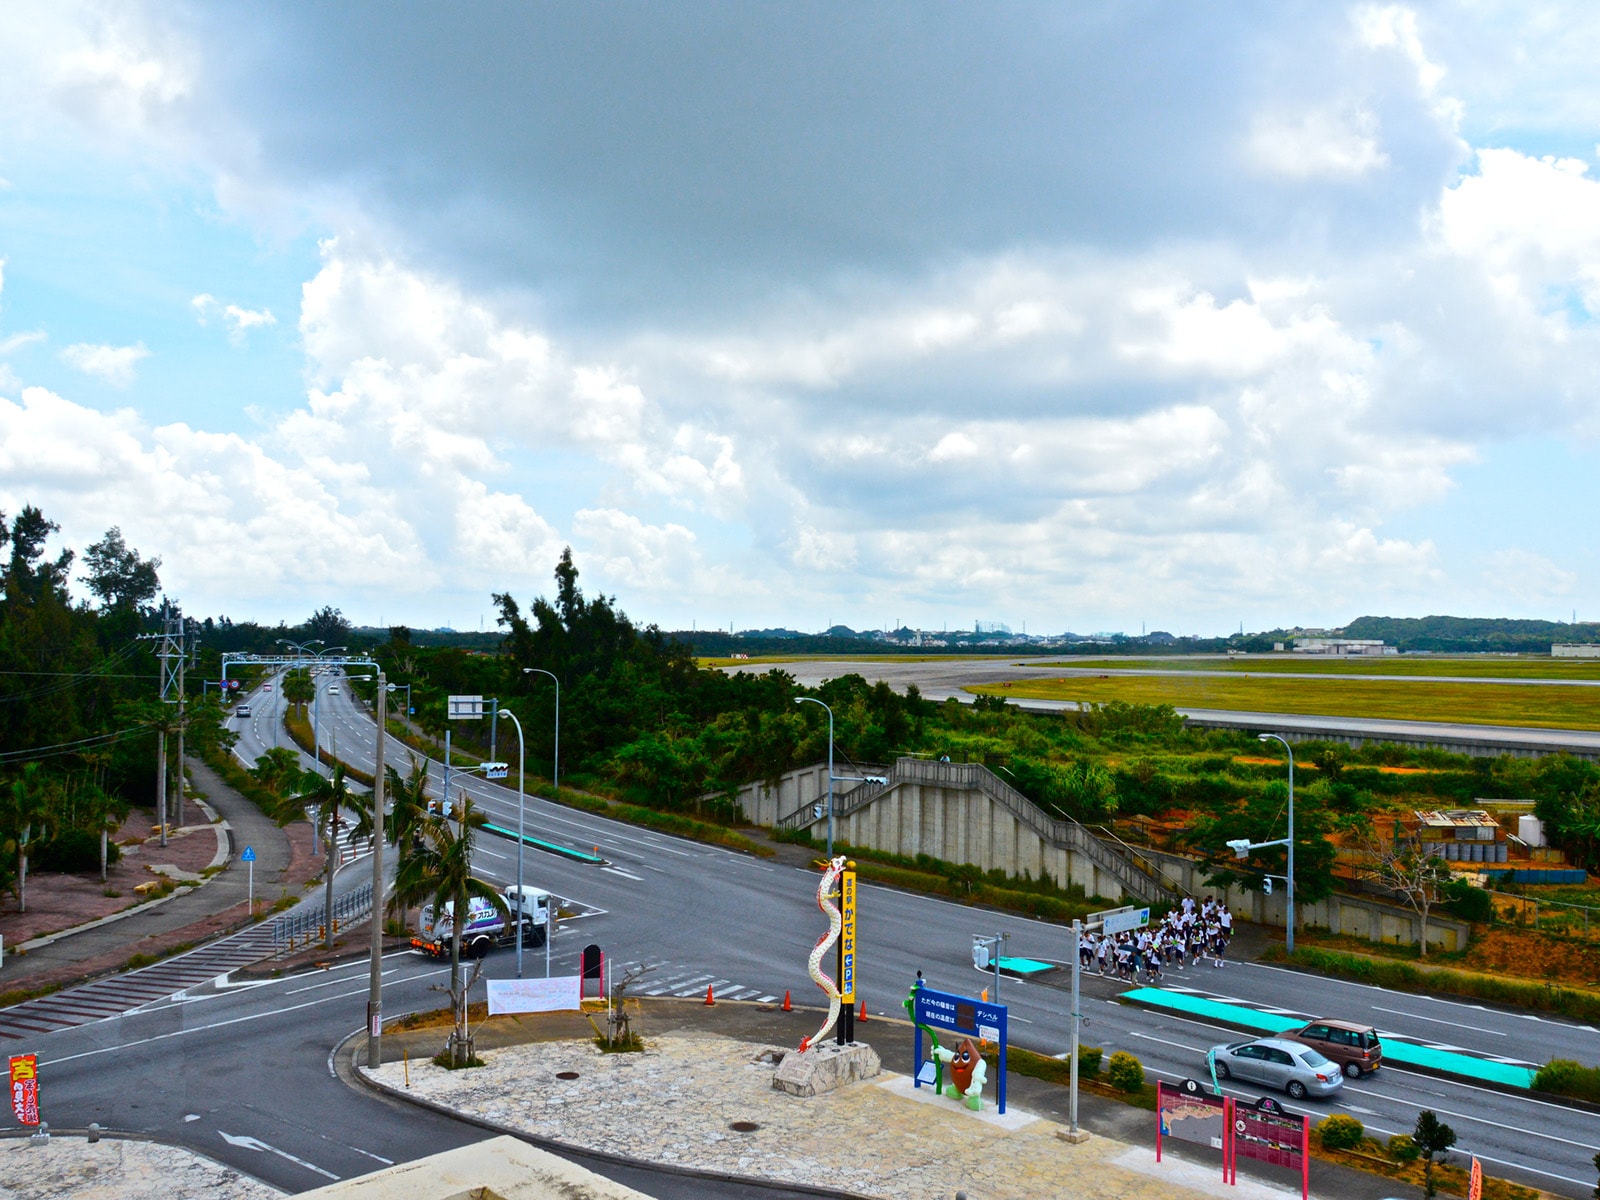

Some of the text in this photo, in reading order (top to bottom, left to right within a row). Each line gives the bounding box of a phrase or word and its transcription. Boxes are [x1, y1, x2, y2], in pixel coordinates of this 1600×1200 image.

[844, 908, 853, 950] かでな
[977, 1010, 998, 1020] デシベル
